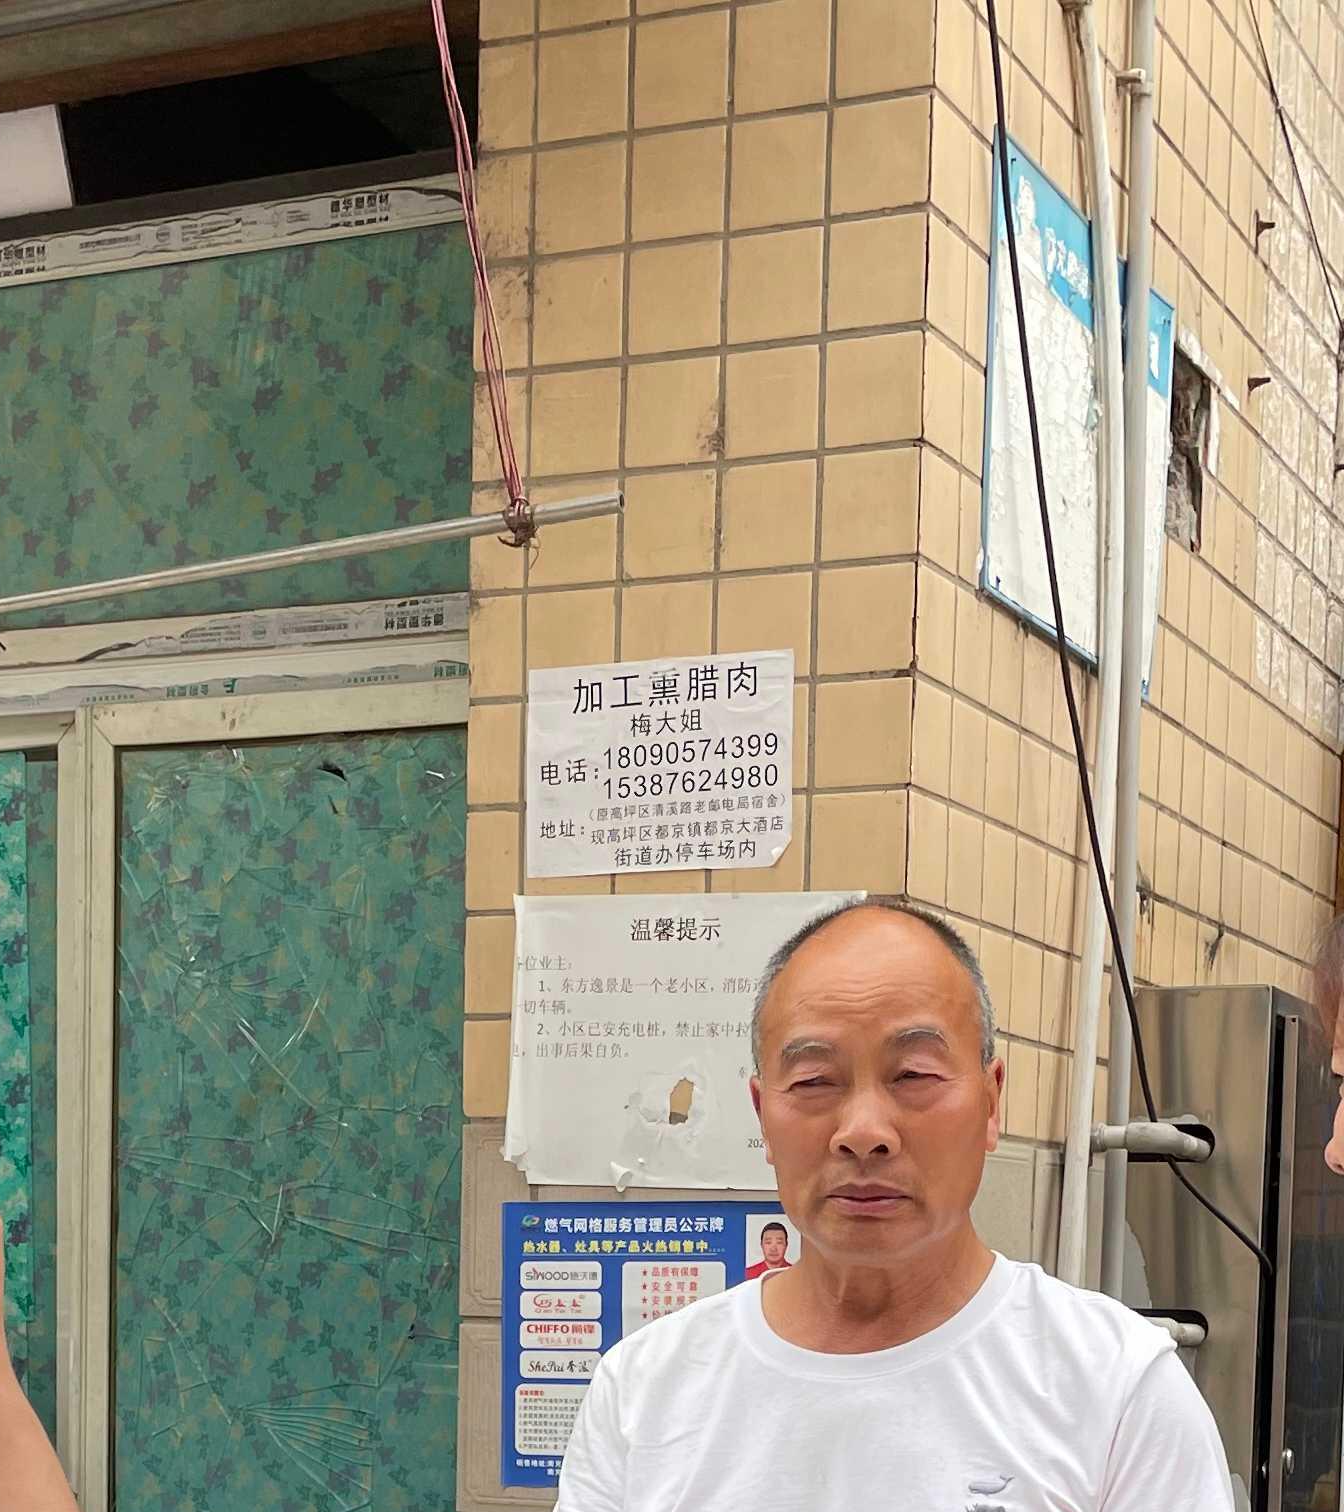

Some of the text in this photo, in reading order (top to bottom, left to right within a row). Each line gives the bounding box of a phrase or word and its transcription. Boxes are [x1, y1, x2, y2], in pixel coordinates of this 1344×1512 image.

[572, 661, 758, 715] 加工熏腊肉
[630, 708, 703, 738] 梅大姐
[603, 732, 779, 771] 18090574399
[603, 763, 779, 800] 15387624980
[614, 838, 757, 868] 街道办停车场内
[630, 917, 722, 943] 温馨提示
[544, 1216, 725, 1234] 燃气网格服务管理员公示牌
[652, 1281, 699, 1293] 安全可靠
[526, 1324, 570, 1335] CHIFFO
